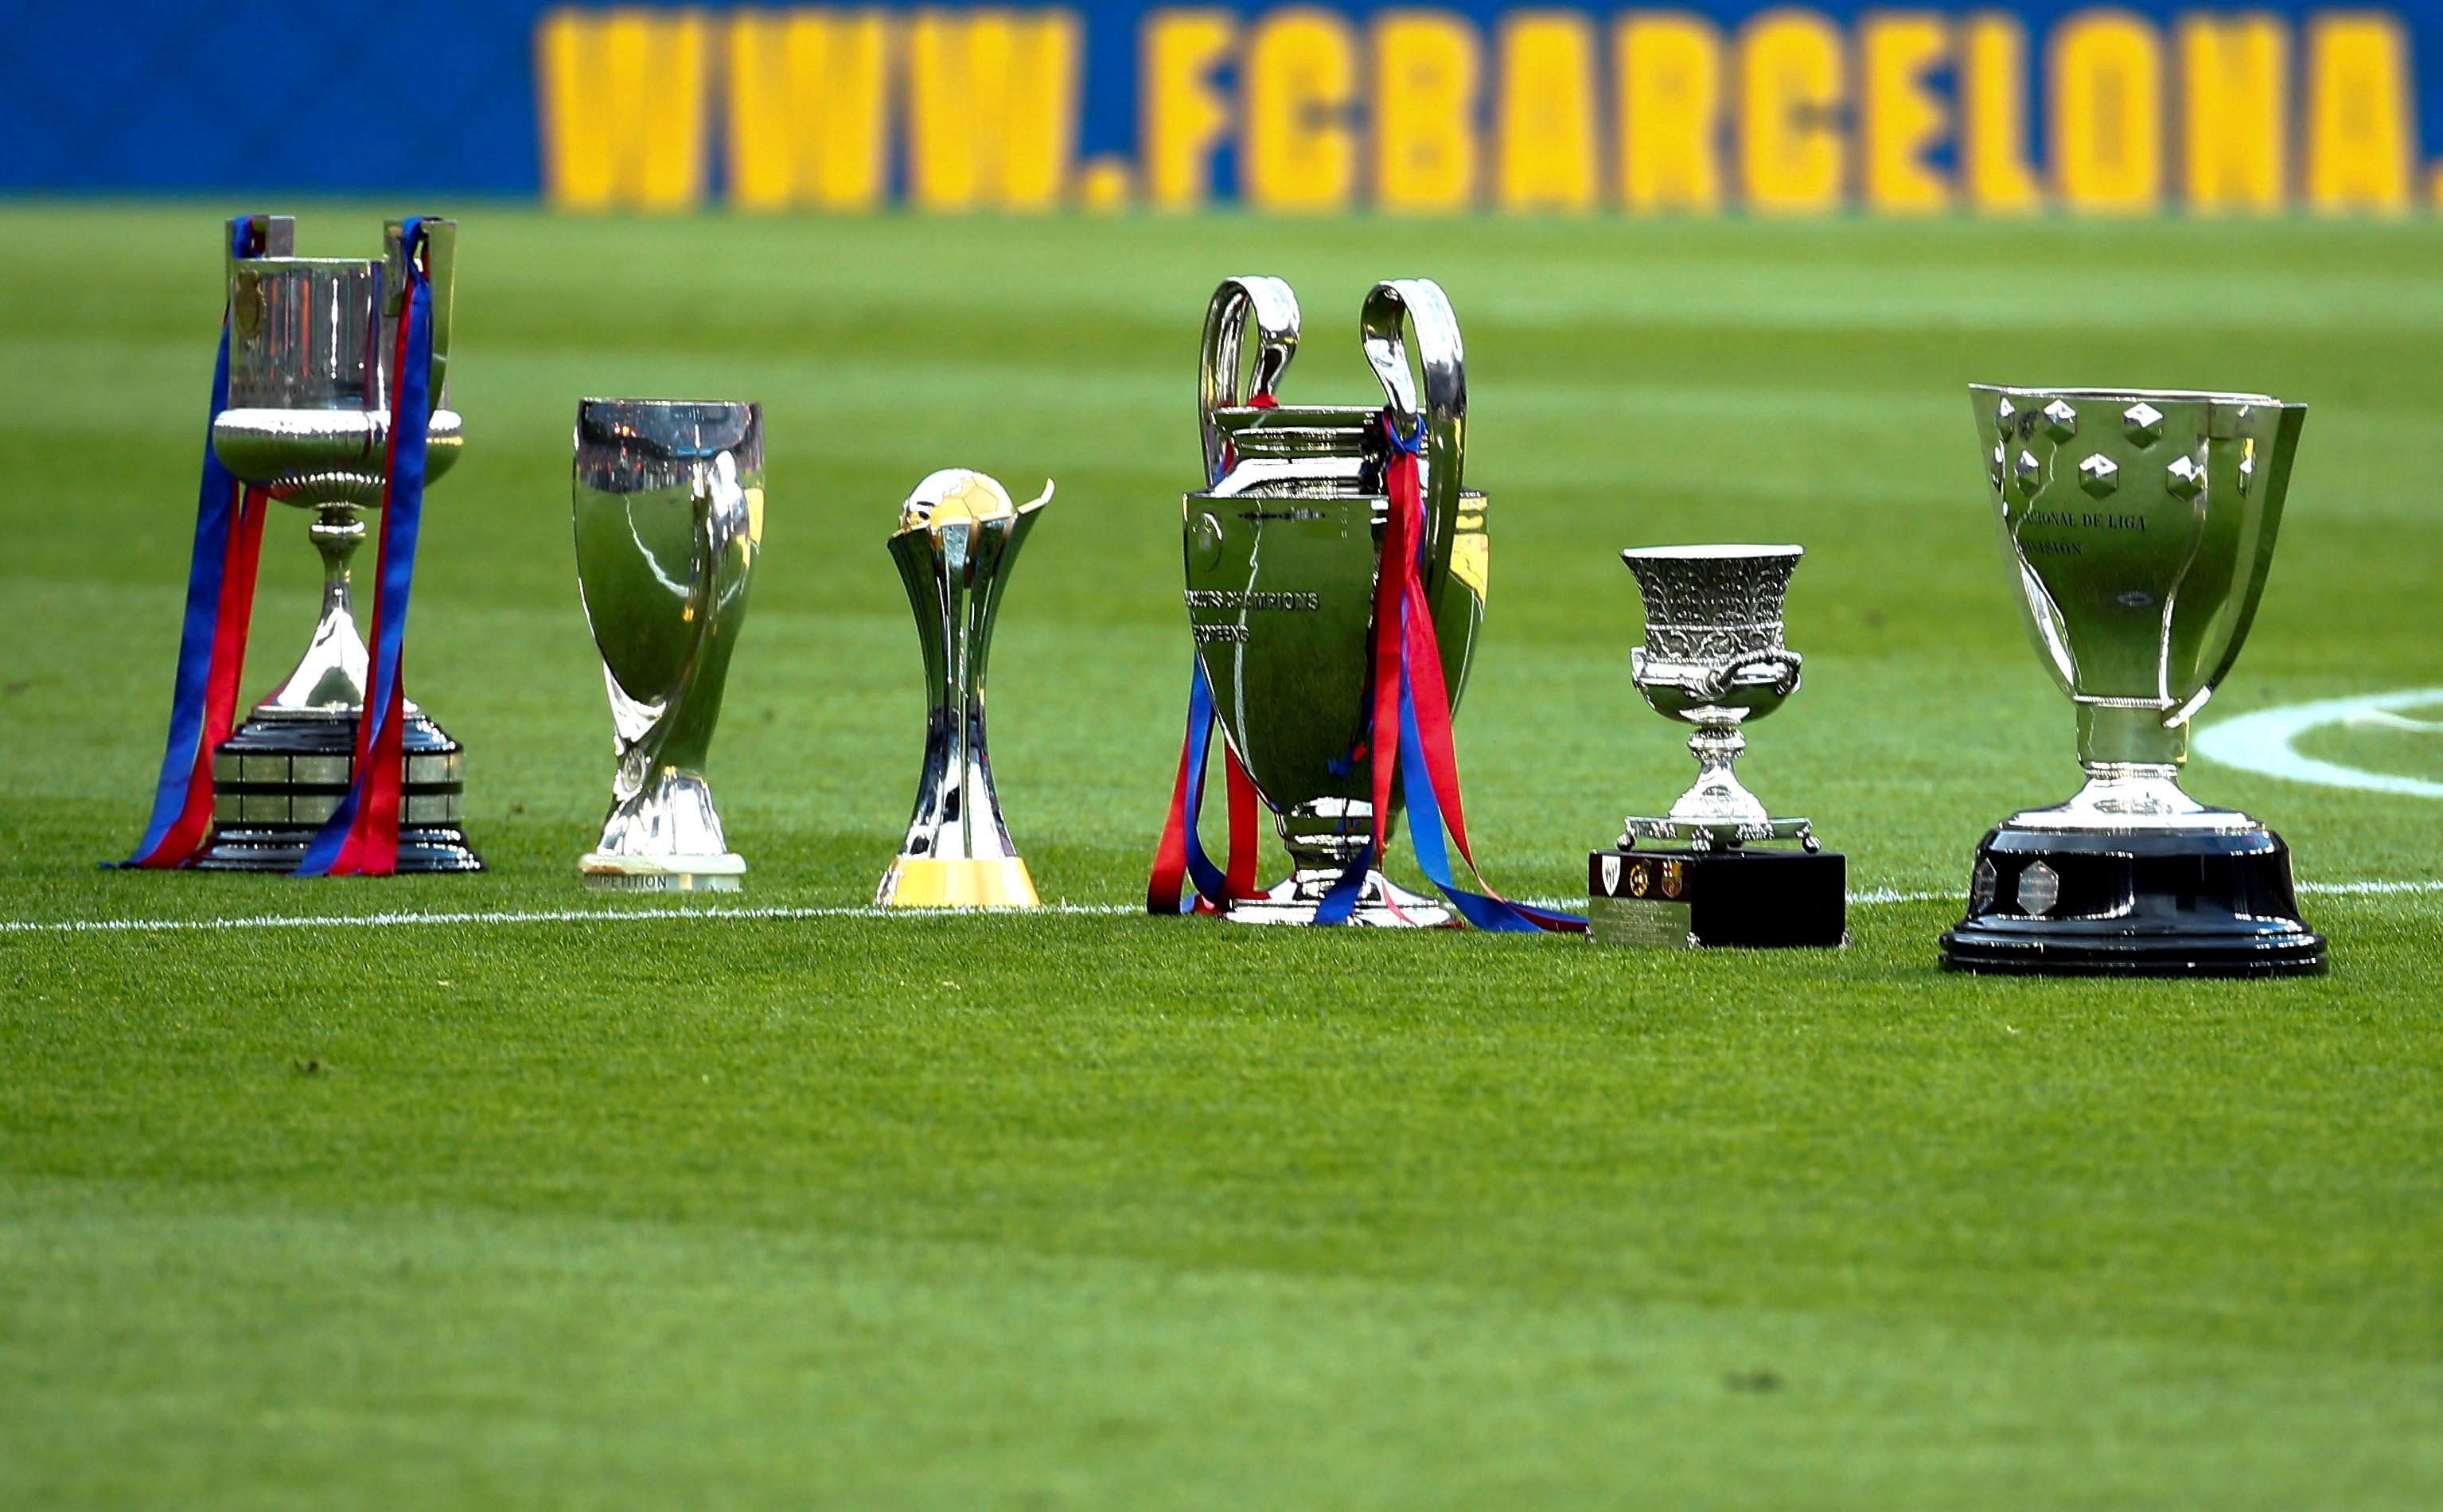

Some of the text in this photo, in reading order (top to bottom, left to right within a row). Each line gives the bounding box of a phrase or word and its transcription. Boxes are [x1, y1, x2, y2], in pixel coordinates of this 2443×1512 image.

[538, 10, 2443, 213] WWW.FCBARCELONA
[2108, 513, 2147, 533] LIGA
[2022, 541, 2083, 556] VISION
[1226, 590, 1320, 611] CHAMPIONS
[585, 874, 668, 889] PETITION
